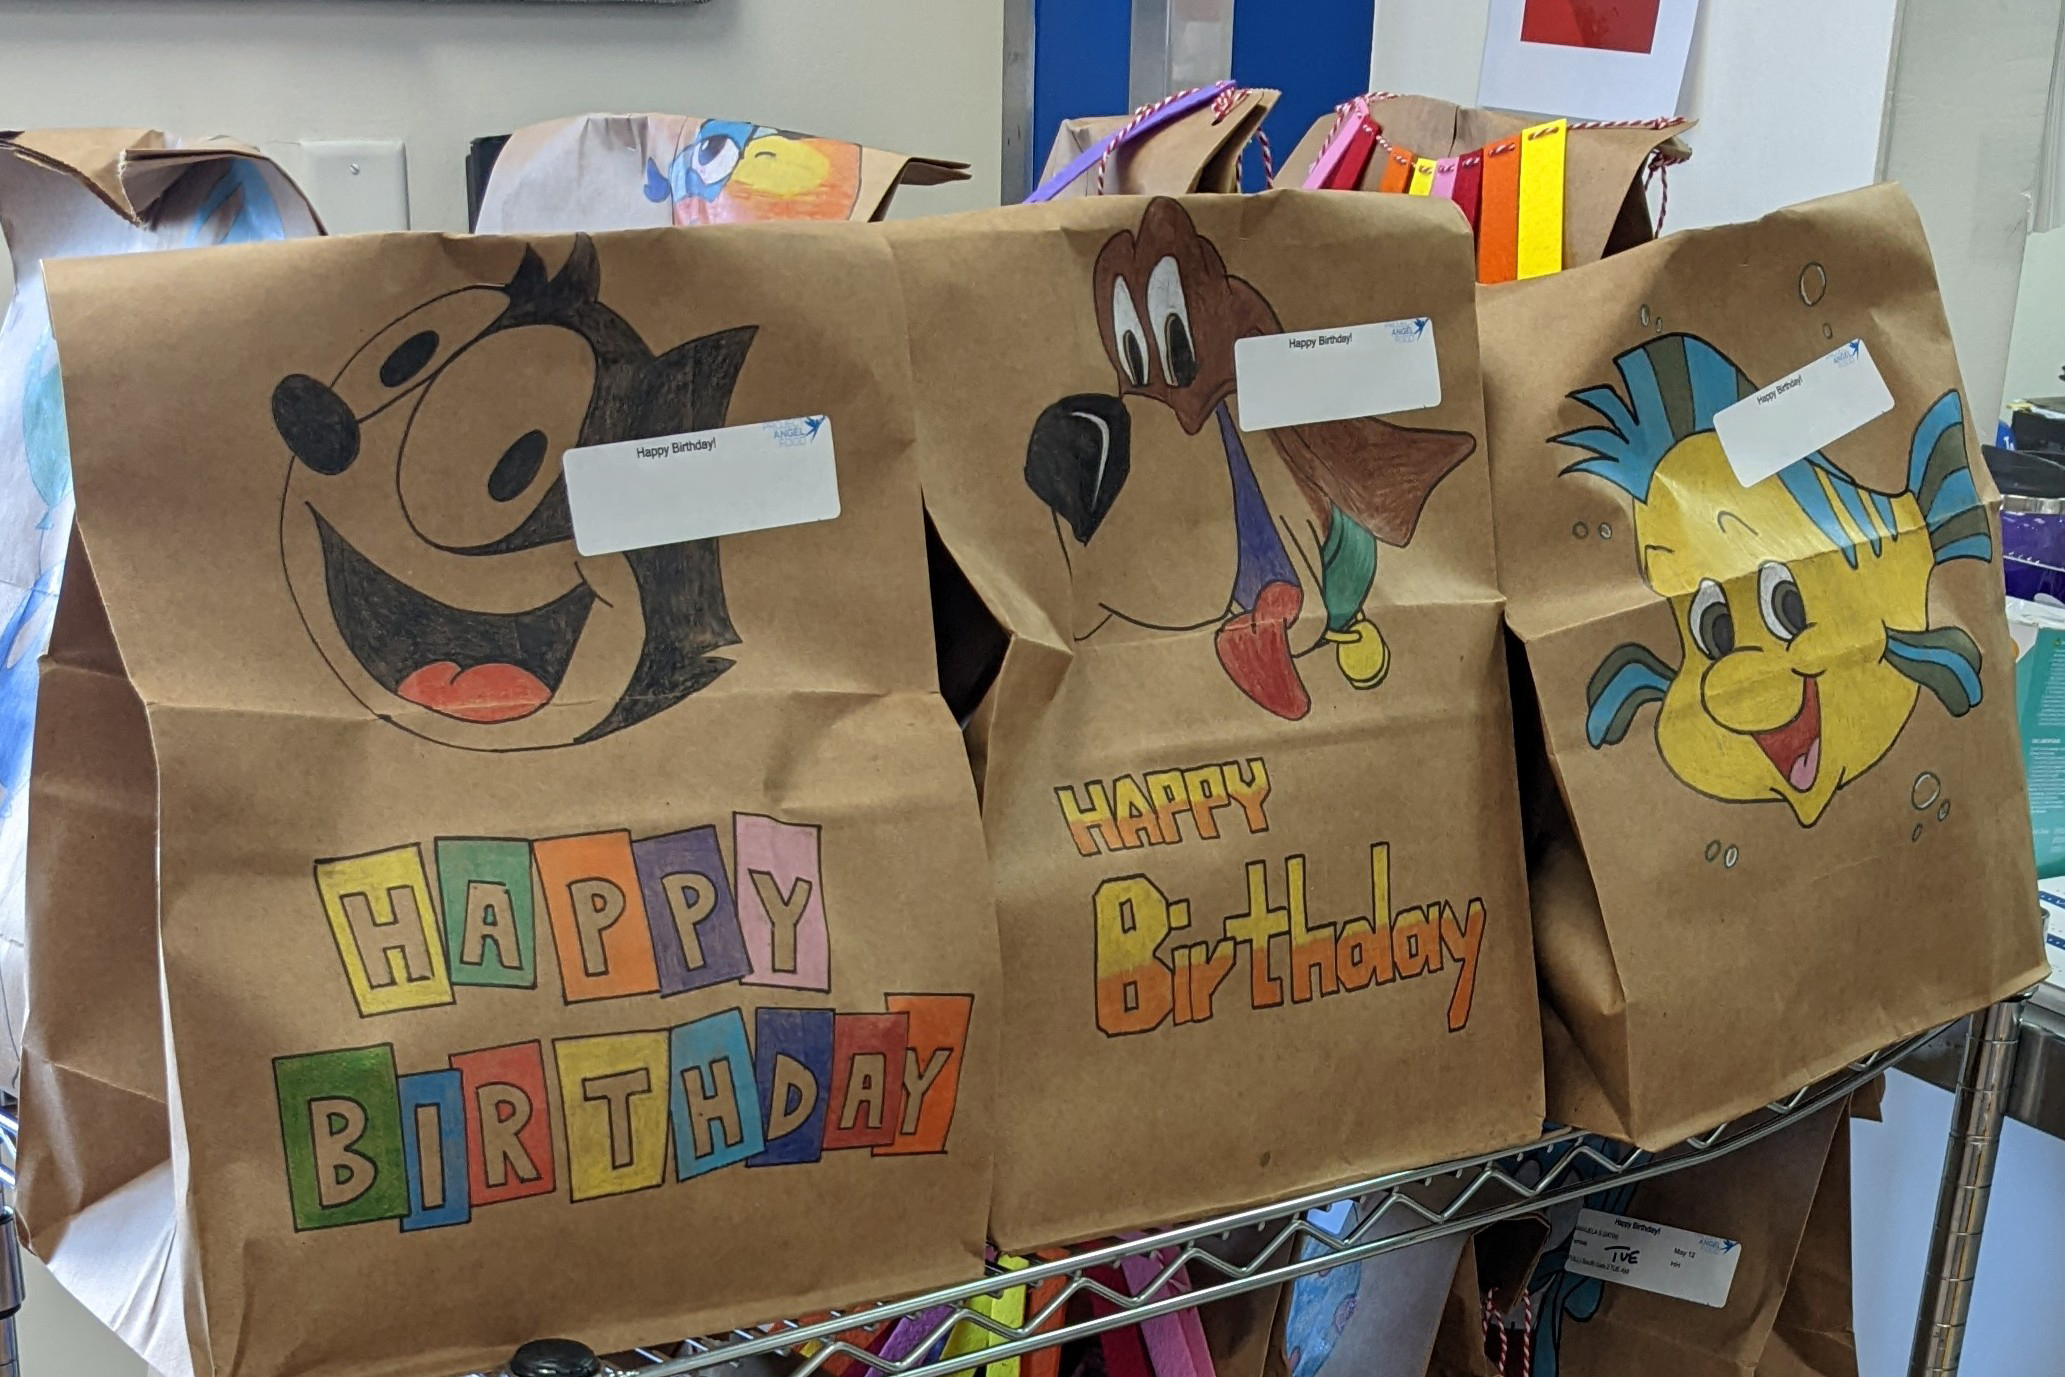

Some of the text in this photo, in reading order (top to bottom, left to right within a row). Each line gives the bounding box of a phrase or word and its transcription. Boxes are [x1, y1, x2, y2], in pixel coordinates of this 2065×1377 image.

[1289, 333, 1353, 350] Happy Birthday!
[1756, 374, 1804, 406] Happy Birthday!
[774, 427, 806, 439] ANGEL
[636, 437, 717, 460] Happy Birthday!
[1054, 757, 1271, 857] HAPPY
[337, 866, 815, 991] HAPPY
[1093, 841, 1487, 1038] Birthday
[307, 1046, 953, 1211] BIRTHDAY
[1614, 1217, 1632, 1230] Happy
[1632, 1221, 1662, 1236] Birthday!
[1604, 1245, 1641, 1265] TUE
[1687, 1250, 1696, 1260] 12
